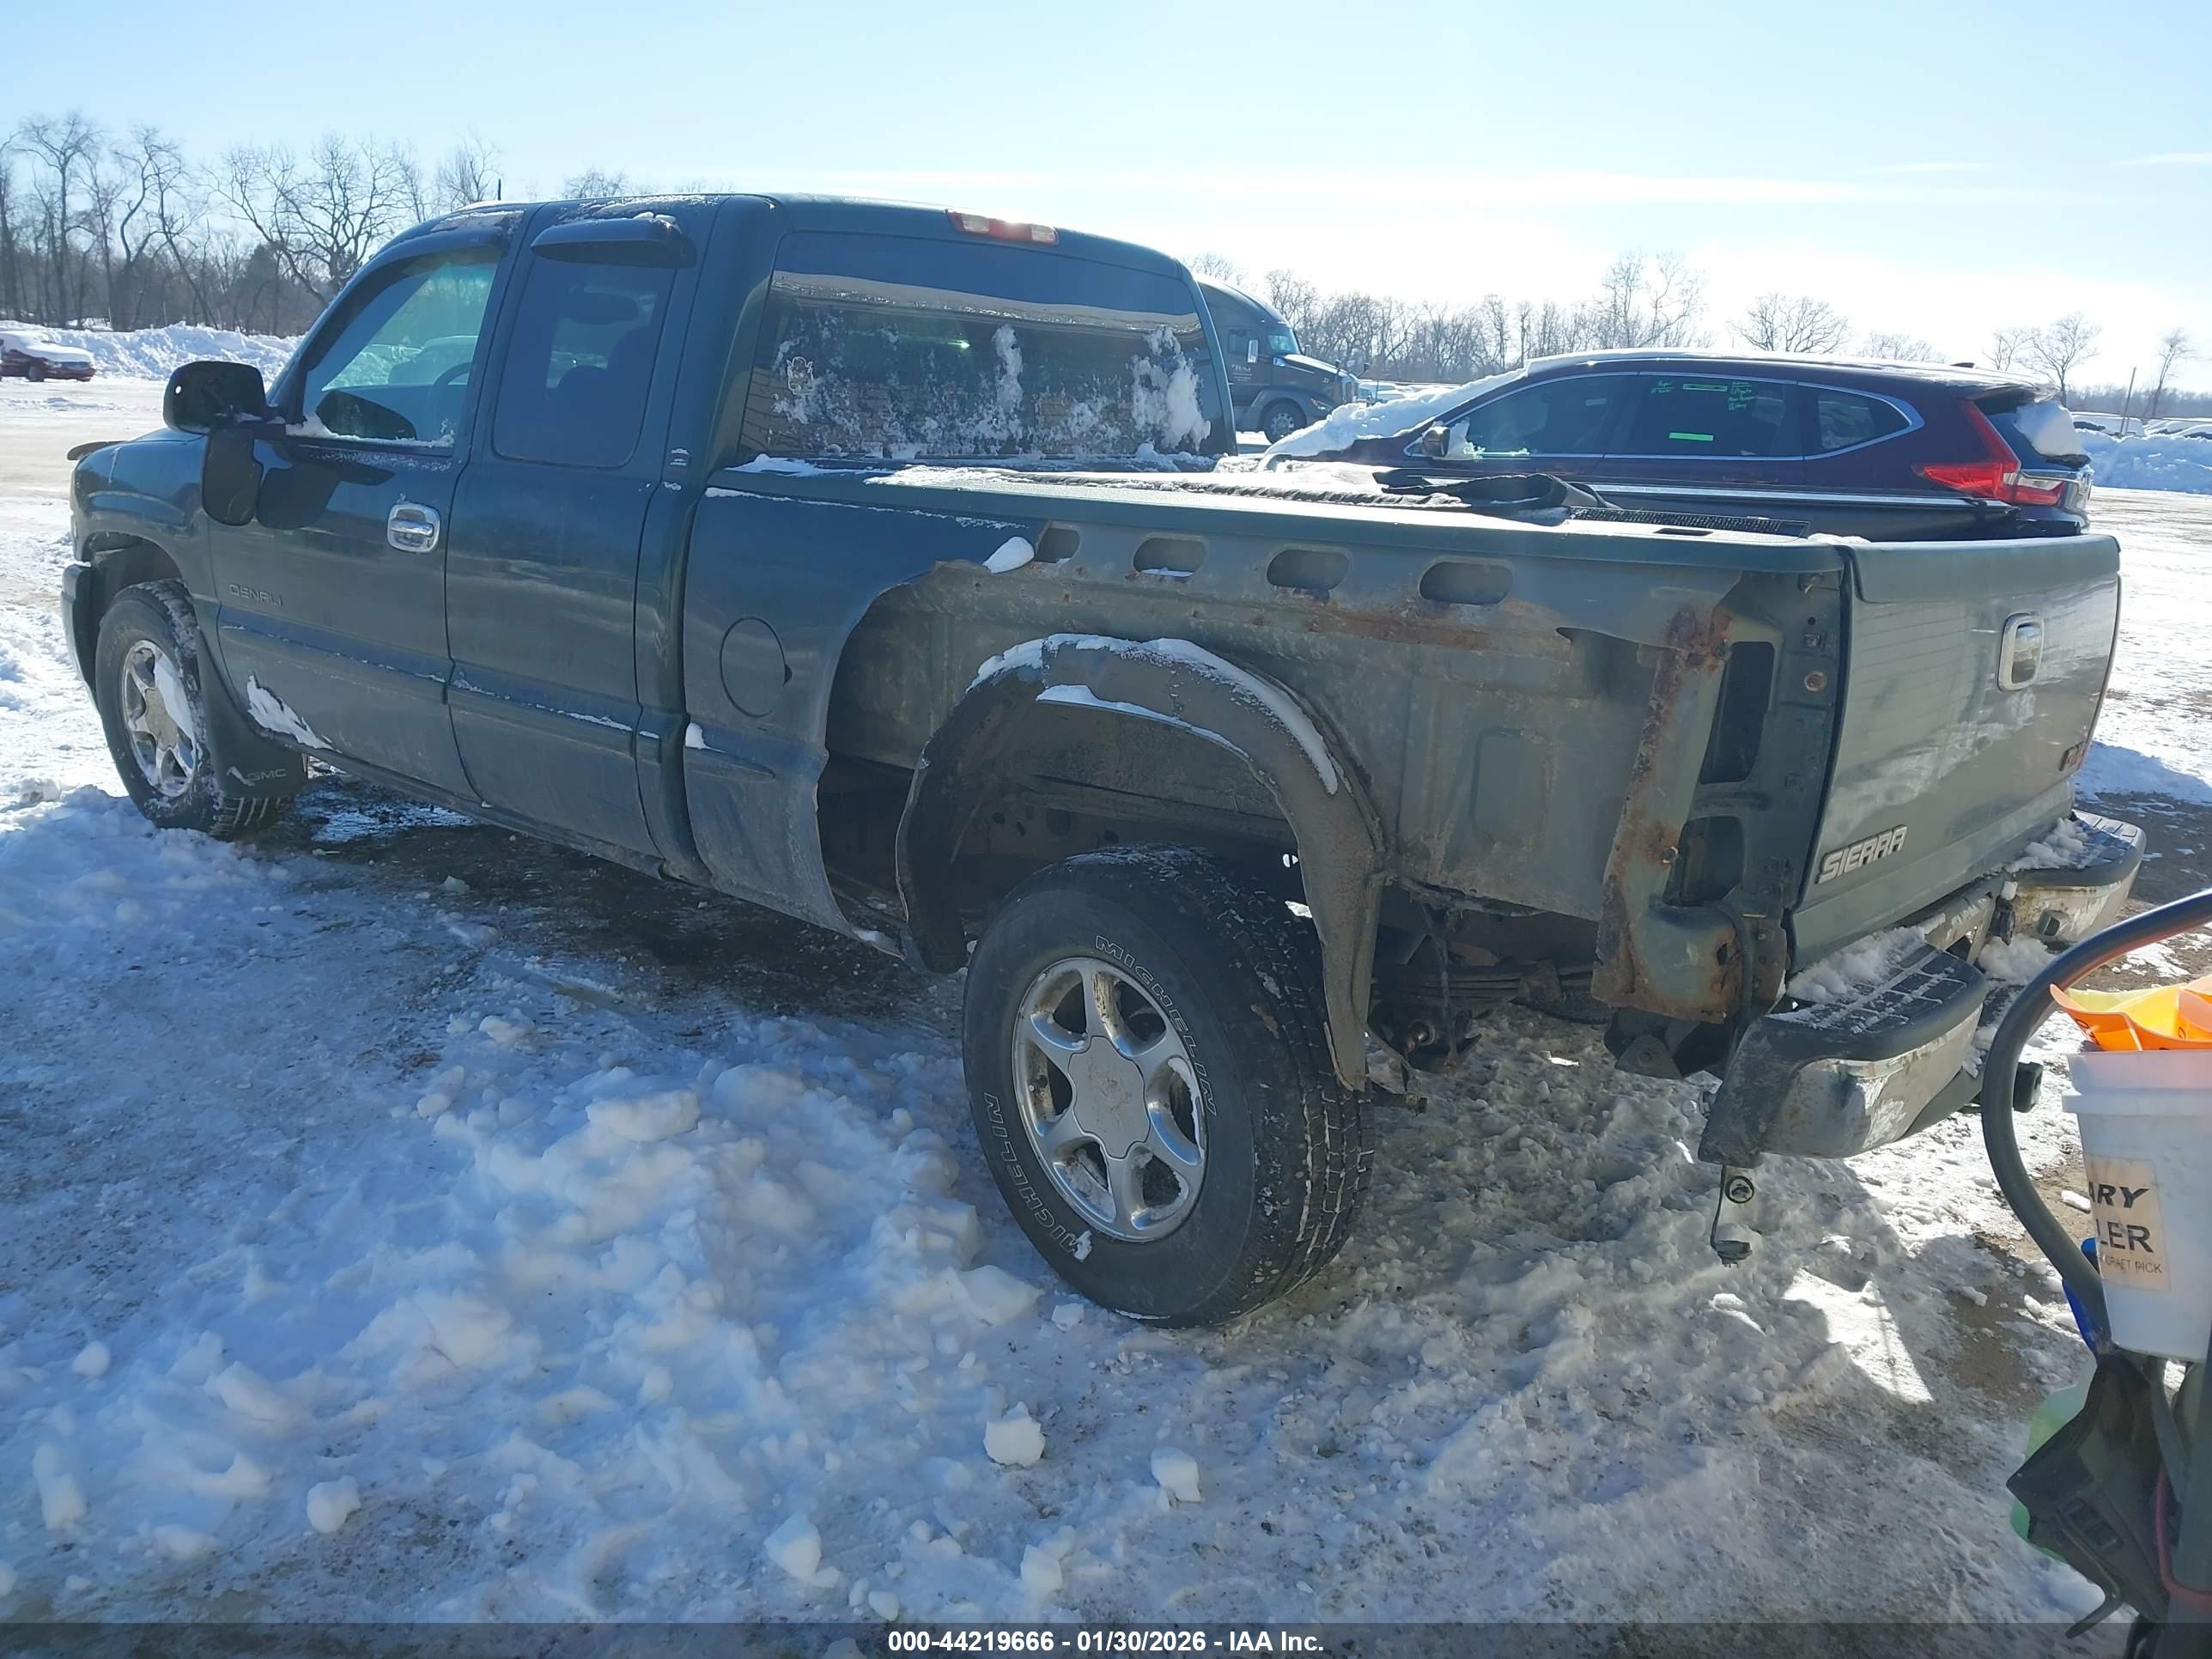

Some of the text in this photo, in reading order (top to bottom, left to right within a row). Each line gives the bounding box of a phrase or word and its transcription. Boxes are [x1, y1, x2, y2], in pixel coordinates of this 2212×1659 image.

[228, 584, 283, 608] DENALI
[247, 769, 287, 781] GMC
[1815, 824, 1907, 884] SIERRA
[1095, 935, 1217, 1115] MICHELIN
